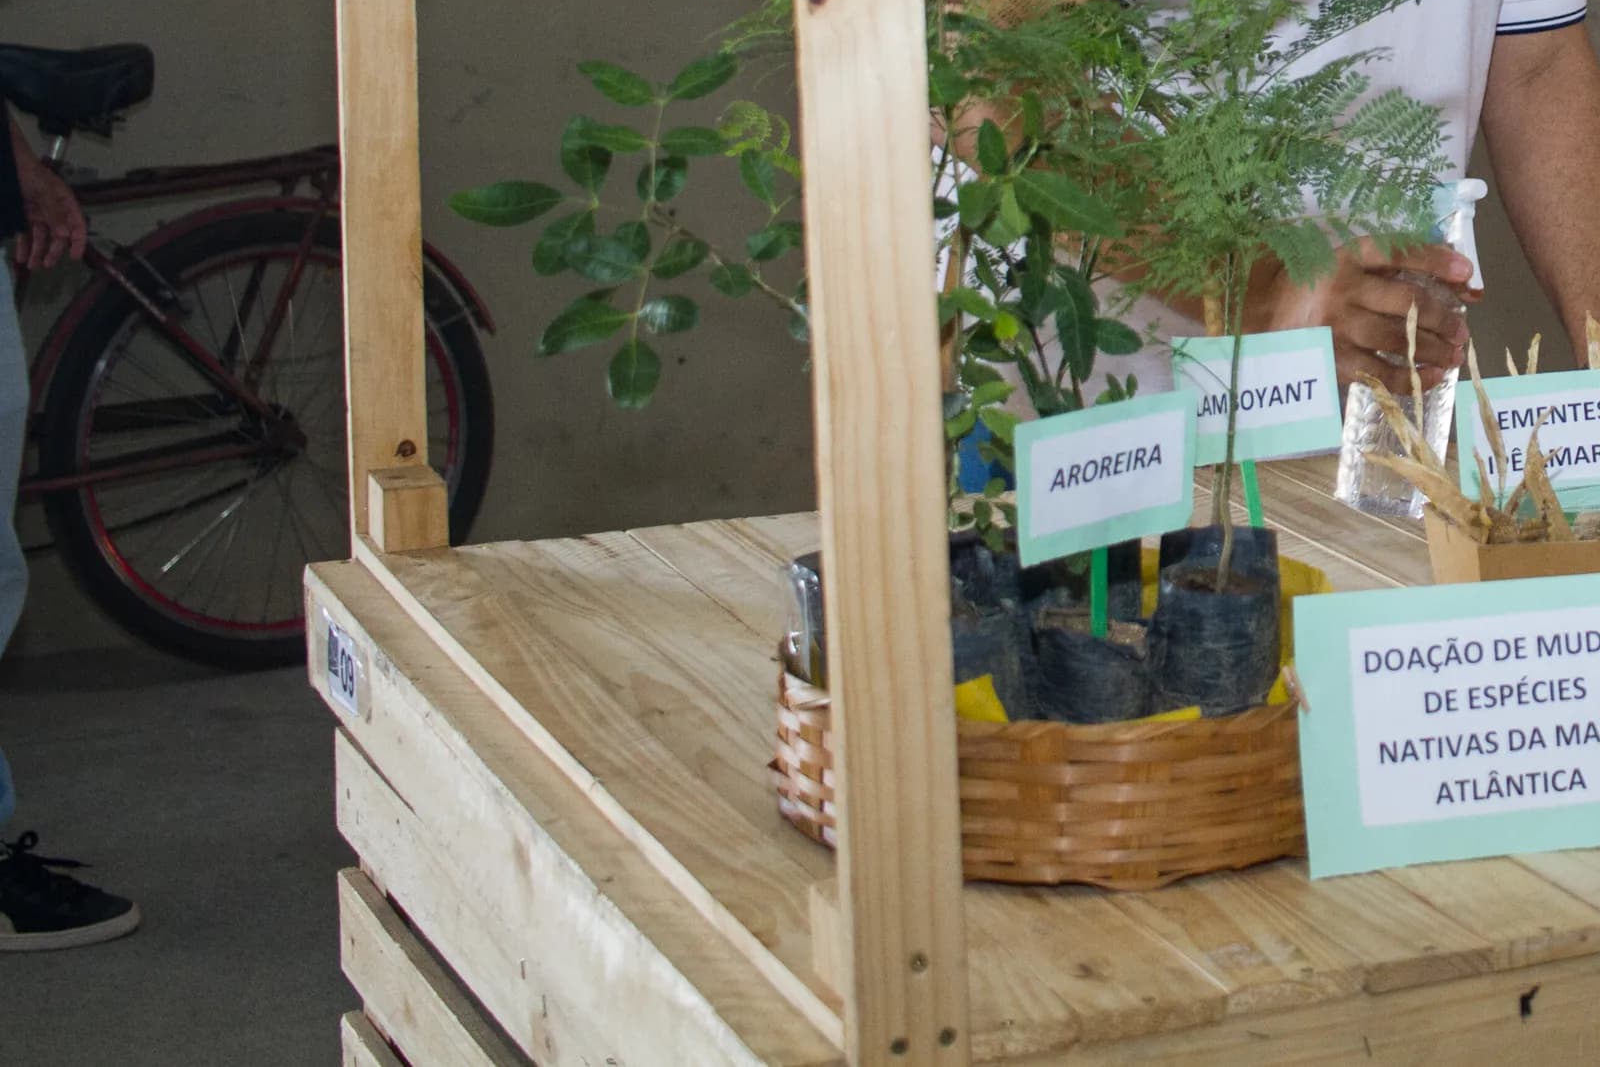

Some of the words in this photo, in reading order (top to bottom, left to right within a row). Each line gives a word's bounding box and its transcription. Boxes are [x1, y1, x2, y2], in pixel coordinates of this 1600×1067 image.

[1050, 444, 1162, 492] AROREIRA
[1488, 447, 1523, 475] IÊ
[341, 648, 354, 698] 09
[1363, 637, 1484, 674] DOAÇÃO
[1493, 637, 1527, 662] DE
[1424, 690, 1460, 714] DE
[1468, 675, 1588, 710] ESPÉCIES
[1379, 730, 1499, 765] NATIVAS
[1508, 726, 1546, 751] DA
[1435, 767, 1587, 805] ATLÂNTICA
